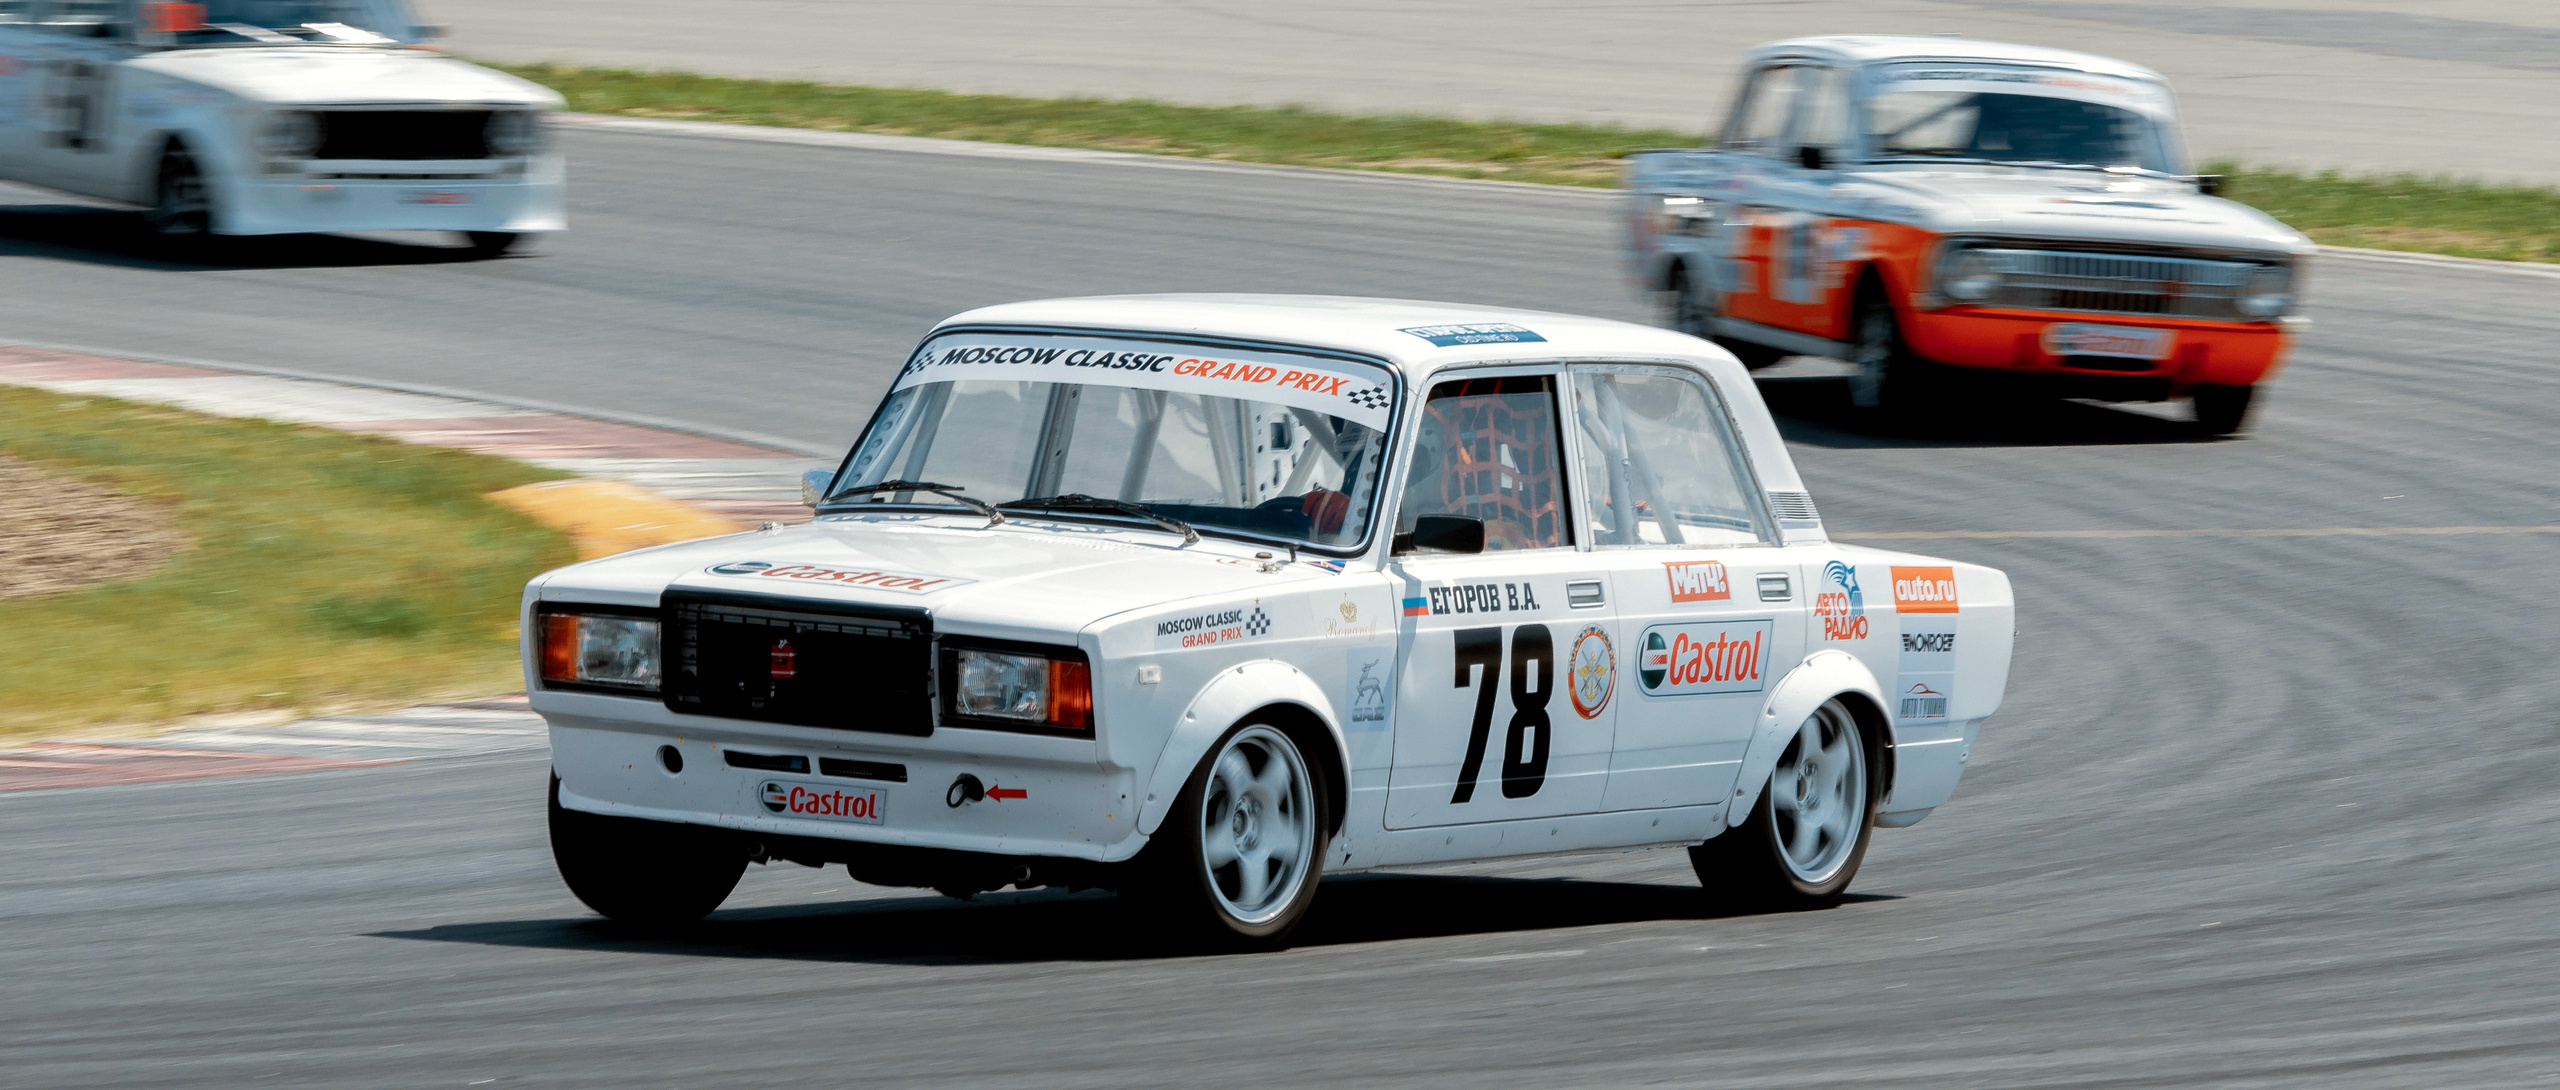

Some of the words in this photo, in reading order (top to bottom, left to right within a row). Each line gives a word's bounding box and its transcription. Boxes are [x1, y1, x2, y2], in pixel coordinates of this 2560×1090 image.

[938, 347, 1069, 366] MOSCOW
[1064, 349, 1173, 373] CLASSIC
[1173, 358, 1278, 384] GRAND
[1275, 370, 1350, 396] PRIX
[760, 565, 951, 591] Castrol
[1895, 575, 1956, 602] auto.ru
[1429, 583, 1501, 615] ЕГОРОВ
[1505, 582, 1540, 611] В.А.
[1813, 592, 1849, 616] АВТО
[1157, 616, 1204, 637] MOSCOW
[1205, 609, 1243, 627] CLASSIC
[1824, 616, 1869, 641] РАДИО
[1181, 633, 1218, 648] GRAND
[1220, 626, 1243, 642] PRIX
[1907, 633, 1950, 652] MONROE
[1669, 630, 1762, 686] Castrol
[1450, 623, 1554, 804] 78
[789, 786, 878, 819] Castrol
